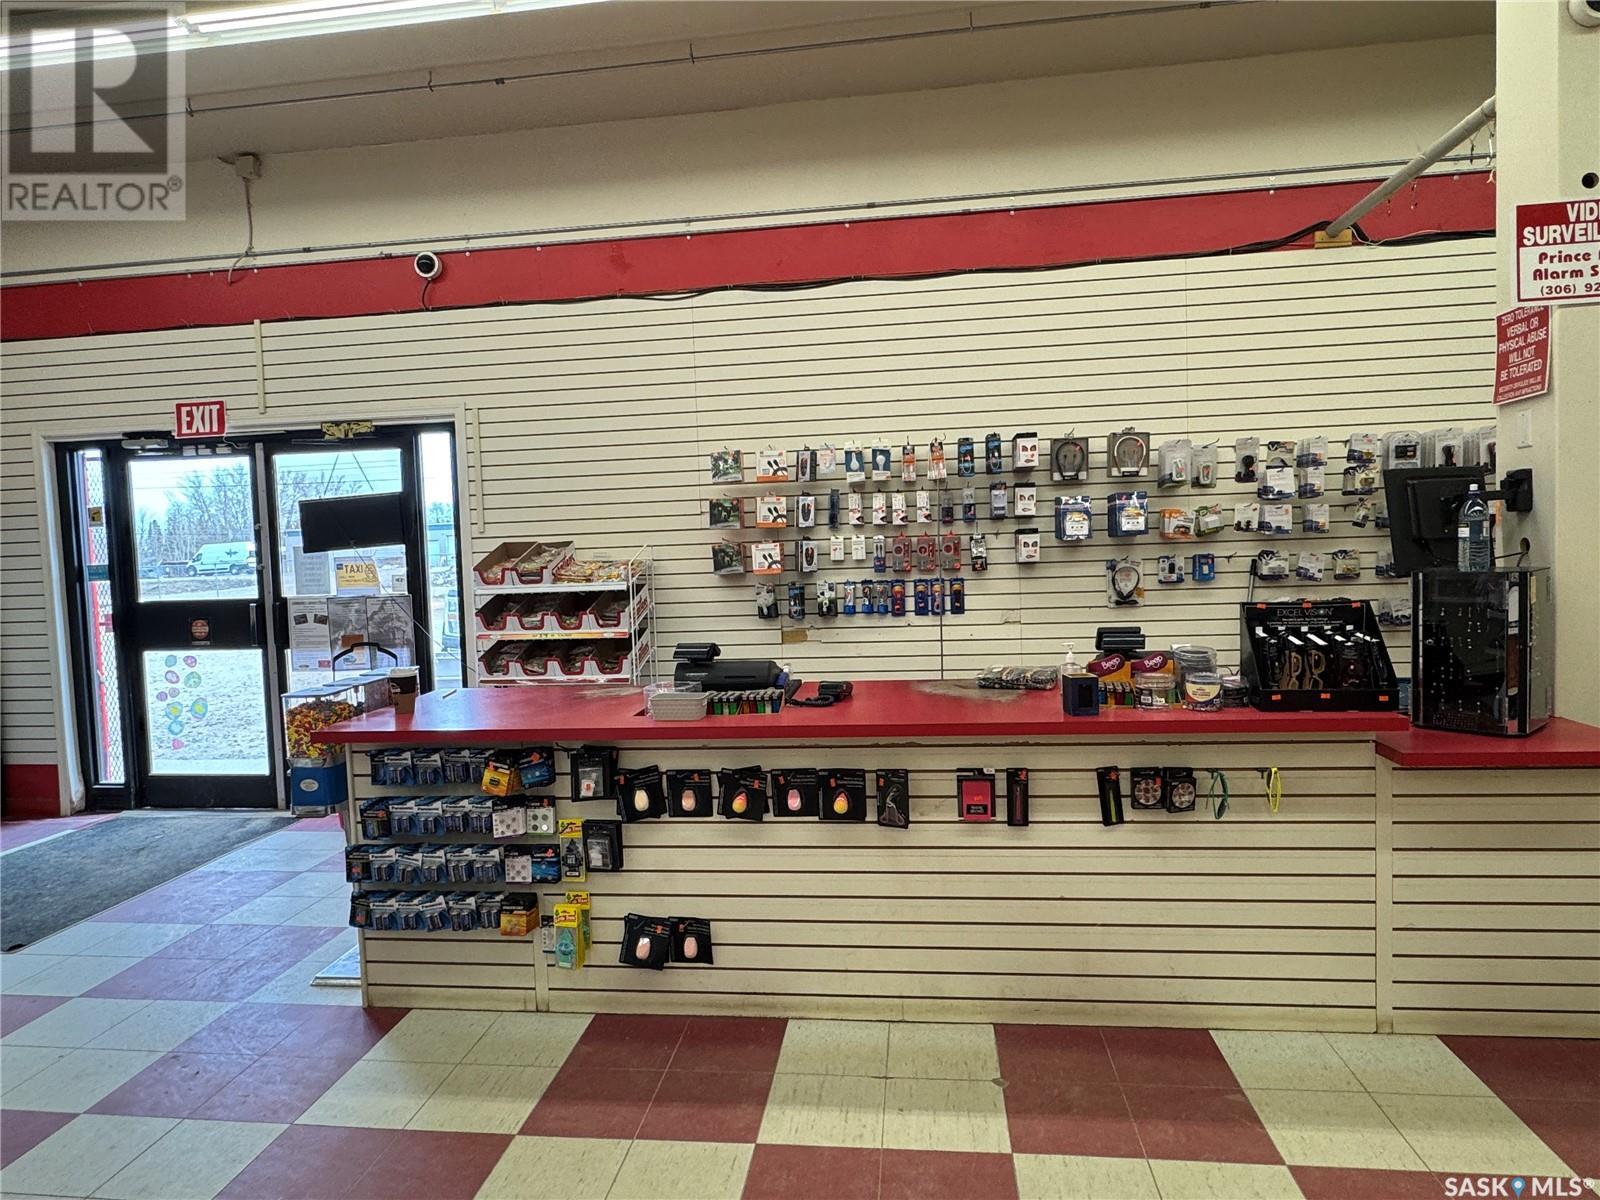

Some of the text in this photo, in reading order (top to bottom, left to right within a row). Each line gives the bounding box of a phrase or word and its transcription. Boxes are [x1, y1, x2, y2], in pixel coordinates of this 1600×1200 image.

[1566, 201, 1600, 222] VID
[1538, 250, 1591, 264] Prince
[1532, 267, 1584, 281] Alarm
[1540, 284, 1576, 296] (306)
[1506, 316, 1539, 338] VERBAL OR
[1498, 326, 1548, 354] PHYSICAL ABUSE
[1508, 344, 1537, 364] WILL NOT
[1500, 358, 1543, 381] BE TOLERATED
[181, 404, 220, 434] EXIT
[344, 563, 364, 575] TAXI
[1277, 608, 1303, 616] EXCEL
